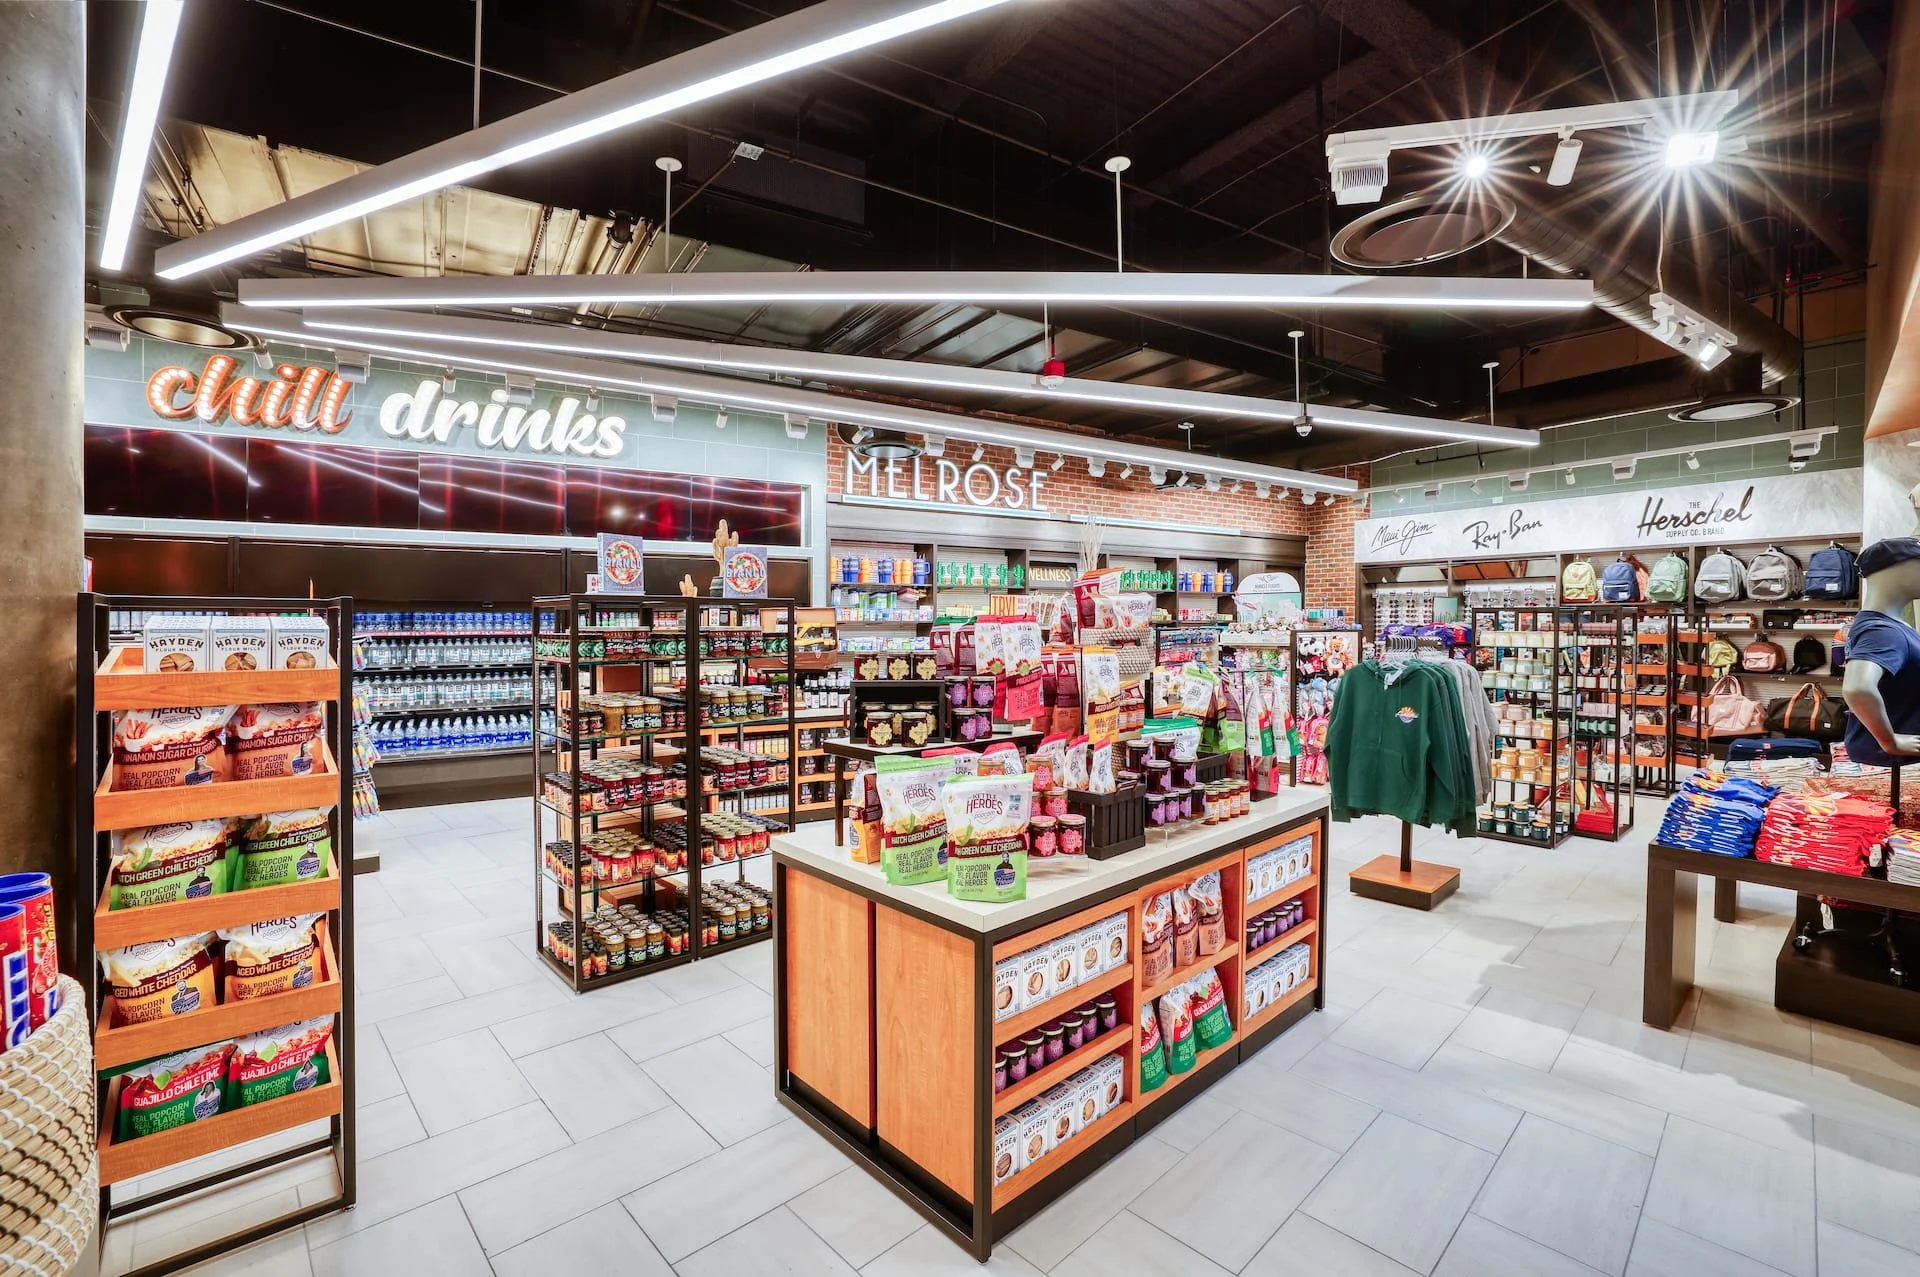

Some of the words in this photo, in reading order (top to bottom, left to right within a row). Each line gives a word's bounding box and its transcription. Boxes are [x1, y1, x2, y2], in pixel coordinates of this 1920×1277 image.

[146, 354, 353, 433] chill
[379, 379, 627, 458] drinks
[846, 450, 1048, 511] MELROSE
[1637, 486, 1755, 538] Herschel
[1689, 501, 1701, 509] THE
[1462, 509, 1543, 550] Ray-Ban
[1666, 528, 1688, 538] SUPPLY
[1371, 523, 1400, 548] Maui
[1399, 519, 1438, 556] Jim
[149, 638, 204, 649] HAYDEN
[215, 637, 266, 648] HAYDEN
[278, 637, 325, 648] HAYDEN
[267, 735, 293, 746] SUGAR
[155, 748, 186, 760] SUGAR
[253, 753, 288, 764] POPCORN
[141, 767, 181, 778] POPCORN
[256, 761, 284, 771] FLAVOR
[255, 768, 284, 779] HEROES
[903, 788, 936, 805] HEROES
[966, 798, 1003, 816] HEROES
[259, 840, 280, 850] GREEN
[280, 836, 300, 847] CHILE
[908, 832, 925, 842] GREEN
[910, 847, 934, 858] POPCORN
[963, 846, 980, 855] GREEN
[980, 843, 997, 854] CHILE
[998, 840, 1023, 852] CHEDDAR
[258, 855, 293, 866] POPCORN
[913, 853, 933, 864] FLAVOR
[136, 869, 164, 881] GREEN
[164, 860, 189, 875] CHILE
[262, 863, 288, 874] FLAVOR
[912, 861, 933, 871] HEROES
[260, 870, 288, 881] HEROES
[965, 871, 988, 880] FLAVOR
[140, 883, 181, 898] POPCORN
[1052, 944, 1076, 960] HAYDEN
[256, 960, 281, 974] WHITE
[1023, 957, 1049, 973] HAYDEN
[129, 984, 156, 996] WHITE
[156, 963, 197, 990] CHEDDAR
[253, 975, 288, 987] POPCORN
[996, 969, 1018, 982] AYDEN
[240, 1063, 277, 1081] GUAJILLO
[278, 1053, 302, 1070] CHILE
[254, 1075, 290, 1092] POPCORN
[134, 1088, 173, 1107] GUAJILLO
[174, 1077, 202, 1096] CHILE
[150, 1100, 189, 1120] POPCORN
[153, 1111, 185, 1127] FLAVOR
[1023, 1118, 1047, 1138] HAYDEN
[995, 1136, 1017, 1153] AYDEN
